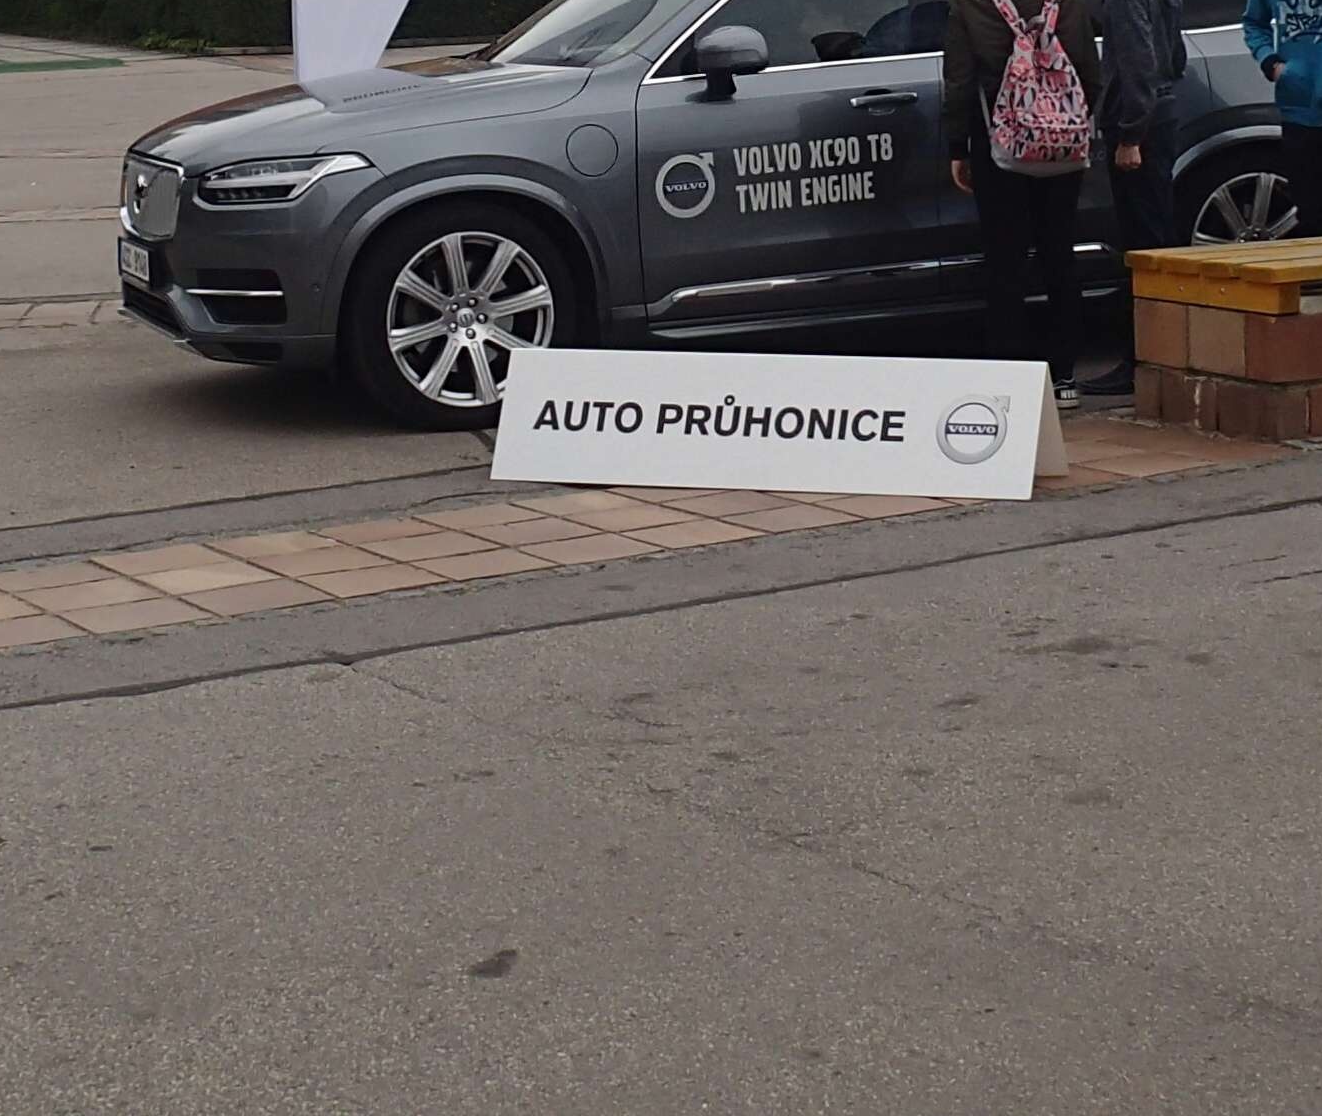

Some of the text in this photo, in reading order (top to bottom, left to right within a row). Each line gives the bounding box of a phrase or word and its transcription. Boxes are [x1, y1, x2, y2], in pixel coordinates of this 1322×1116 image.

[733, 132, 894, 176] VOLVO XC90 T8
[665, 181, 707, 193] VOLVO
[735, 171, 876, 214] TWIN ENGINE
[533, 394, 906, 443] AUTO PRŮHONICE
[948, 425, 996, 434] VOLVO
